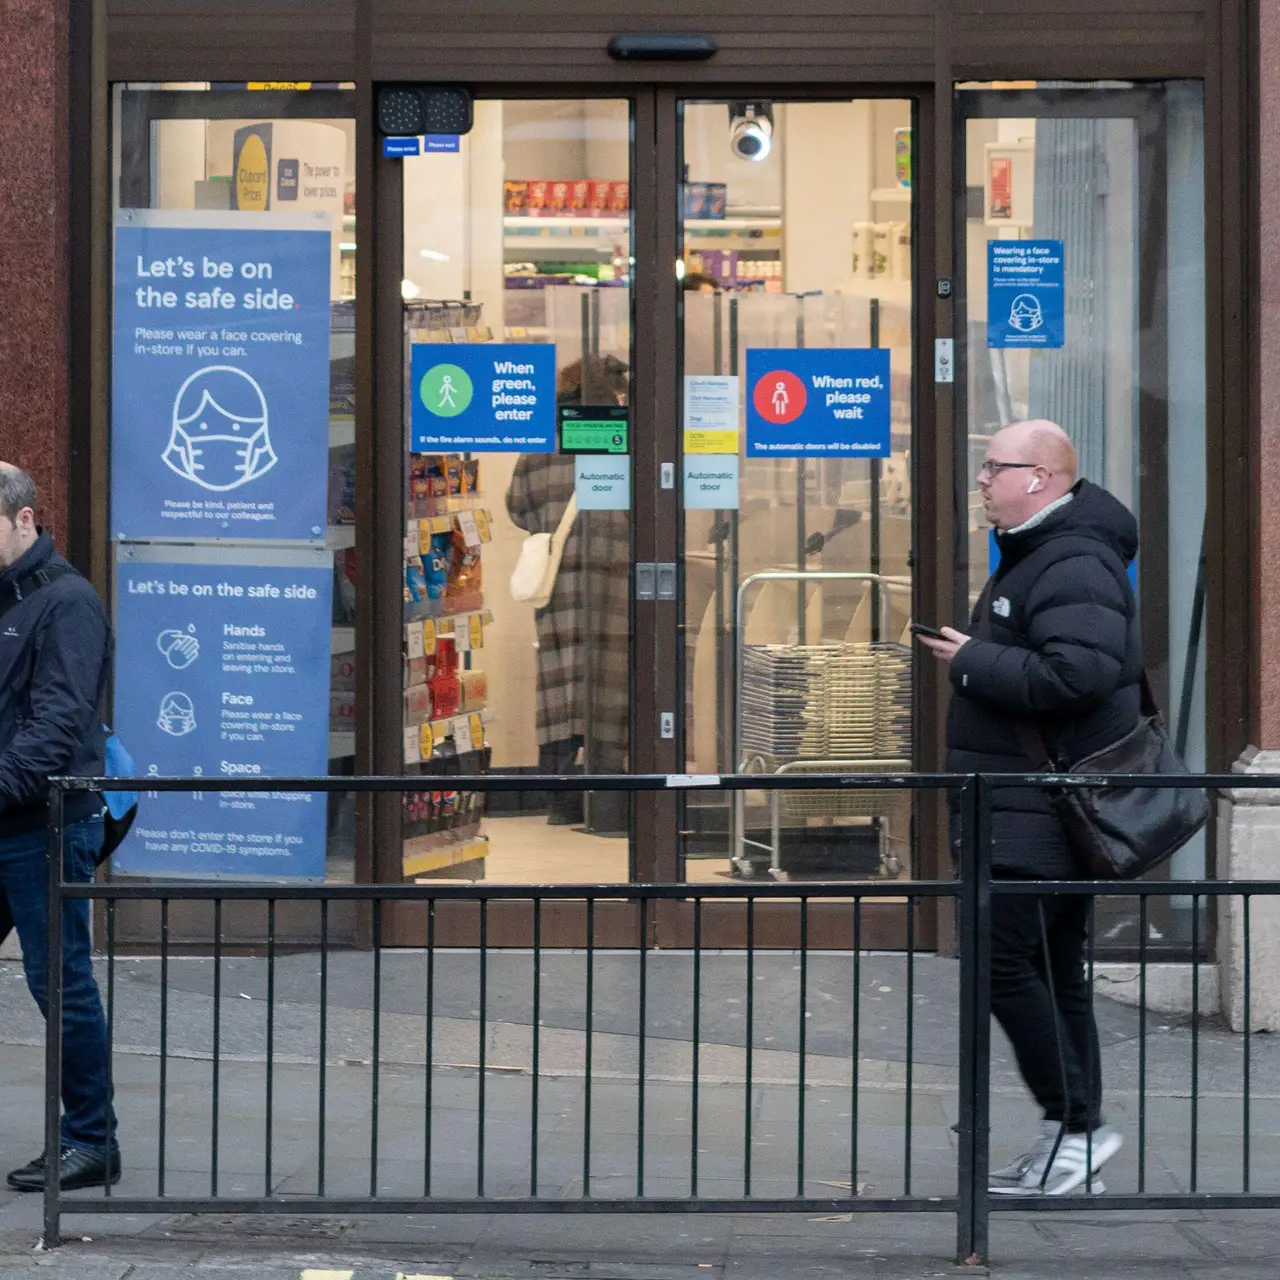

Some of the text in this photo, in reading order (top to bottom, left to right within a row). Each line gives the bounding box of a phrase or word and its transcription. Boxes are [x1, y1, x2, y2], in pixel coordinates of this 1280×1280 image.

[993, 246, 1025, 256] Wearing
[1032, 246, 1050, 255] face
[993, 256, 1060, 265] covering in-store
[137, 255, 272, 279] Let's be on
[136, 286, 300, 310] the safe side.
[135, 328, 302, 345] Please wear a face covering
[134, 343, 183, 355] in-store
[197, 346, 220, 357] you
[222, 346, 248, 356] can.
[494, 361, 534, 374] When
[492, 379, 536, 392] green,
[812, 375, 884, 389] When red,
[492, 392, 537, 408] please
[826, 391, 871, 406] please
[495, 408, 533, 421] enter
[833, 406, 863, 419] wait
[426, 436, 439, 444] the
[439, 436, 452, 444] fire
[453, 436, 474, 444] alarm
[503, 436, 513, 444] do
[514, 436, 526, 444] not
[527, 436, 547, 444] enter
[614, 435, 621, 444] 5
[754, 442, 881, 451] The automatic doors will be disabled
[579, 472, 625, 481] Automatic
[688, 471, 733, 480] Automatic
[592, 483, 613, 492] door
[700, 483, 721, 491] door
[164, 499, 191, 509] Please
[192, 500, 204, 509] be
[227, 501, 257, 511] patient
[258, 502, 274, 510] and
[160, 510, 204, 520] respectful
[205, 511, 214, 519] to
[128, 580, 166, 594] Let's
[169, 581, 189, 595] be
[192, 585, 213, 597] on
[217, 583, 244, 597] the
[247, 584, 281, 599] safe
[224, 624, 266, 637] Hands
[223, 641, 285, 652] Sanitise hands
[222, 653, 291, 664] on entering and
[222, 663, 252, 674] leaving
[254, 664, 270, 672] the
[222, 692, 254, 705] Face
[221, 710, 250, 719] Please
[251, 712, 274, 720] wear
[282, 712, 302, 721] face
[220, 721, 295, 732] covering in-store
[228, 733, 245, 742] you
[220, 761, 261, 775] Space
[136, 827, 168, 838] Please
[198, 832, 224, 841] enter
[227, 832, 245, 842] the
[247, 833, 273, 843] store
[284, 836, 303, 846] you
[145, 841, 292, 857] have any COVID-19 symptoms.
